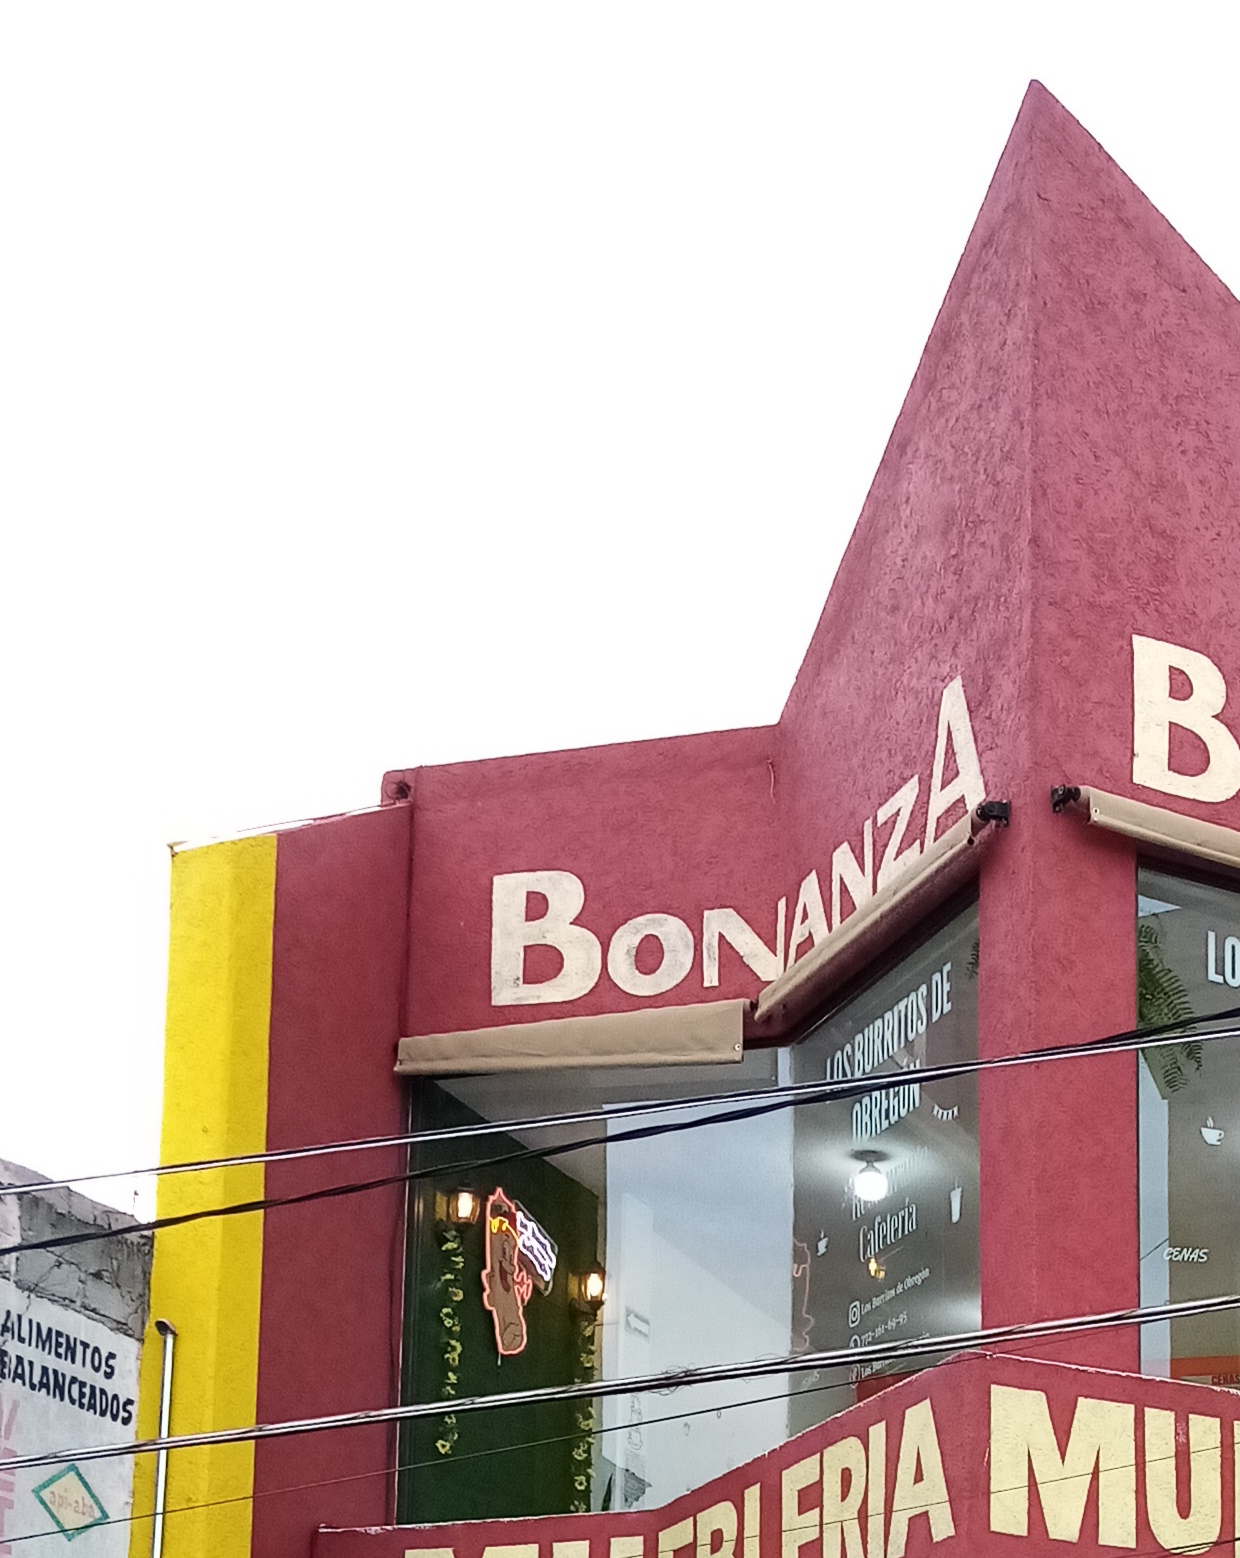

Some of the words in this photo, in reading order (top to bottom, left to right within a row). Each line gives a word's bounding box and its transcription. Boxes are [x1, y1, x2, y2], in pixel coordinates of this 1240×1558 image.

[491, 675, 988, 1005] BONANZA
[854, 984, 928, 1079] BURRITOS
[931, 962, 952, 1023] DE
[859, 1198, 917, 1264] Cafetería
[0, 1309, 118, 1380] ALIMENTOS
[0, 1346, 135, 1427] BALANCEADOS
